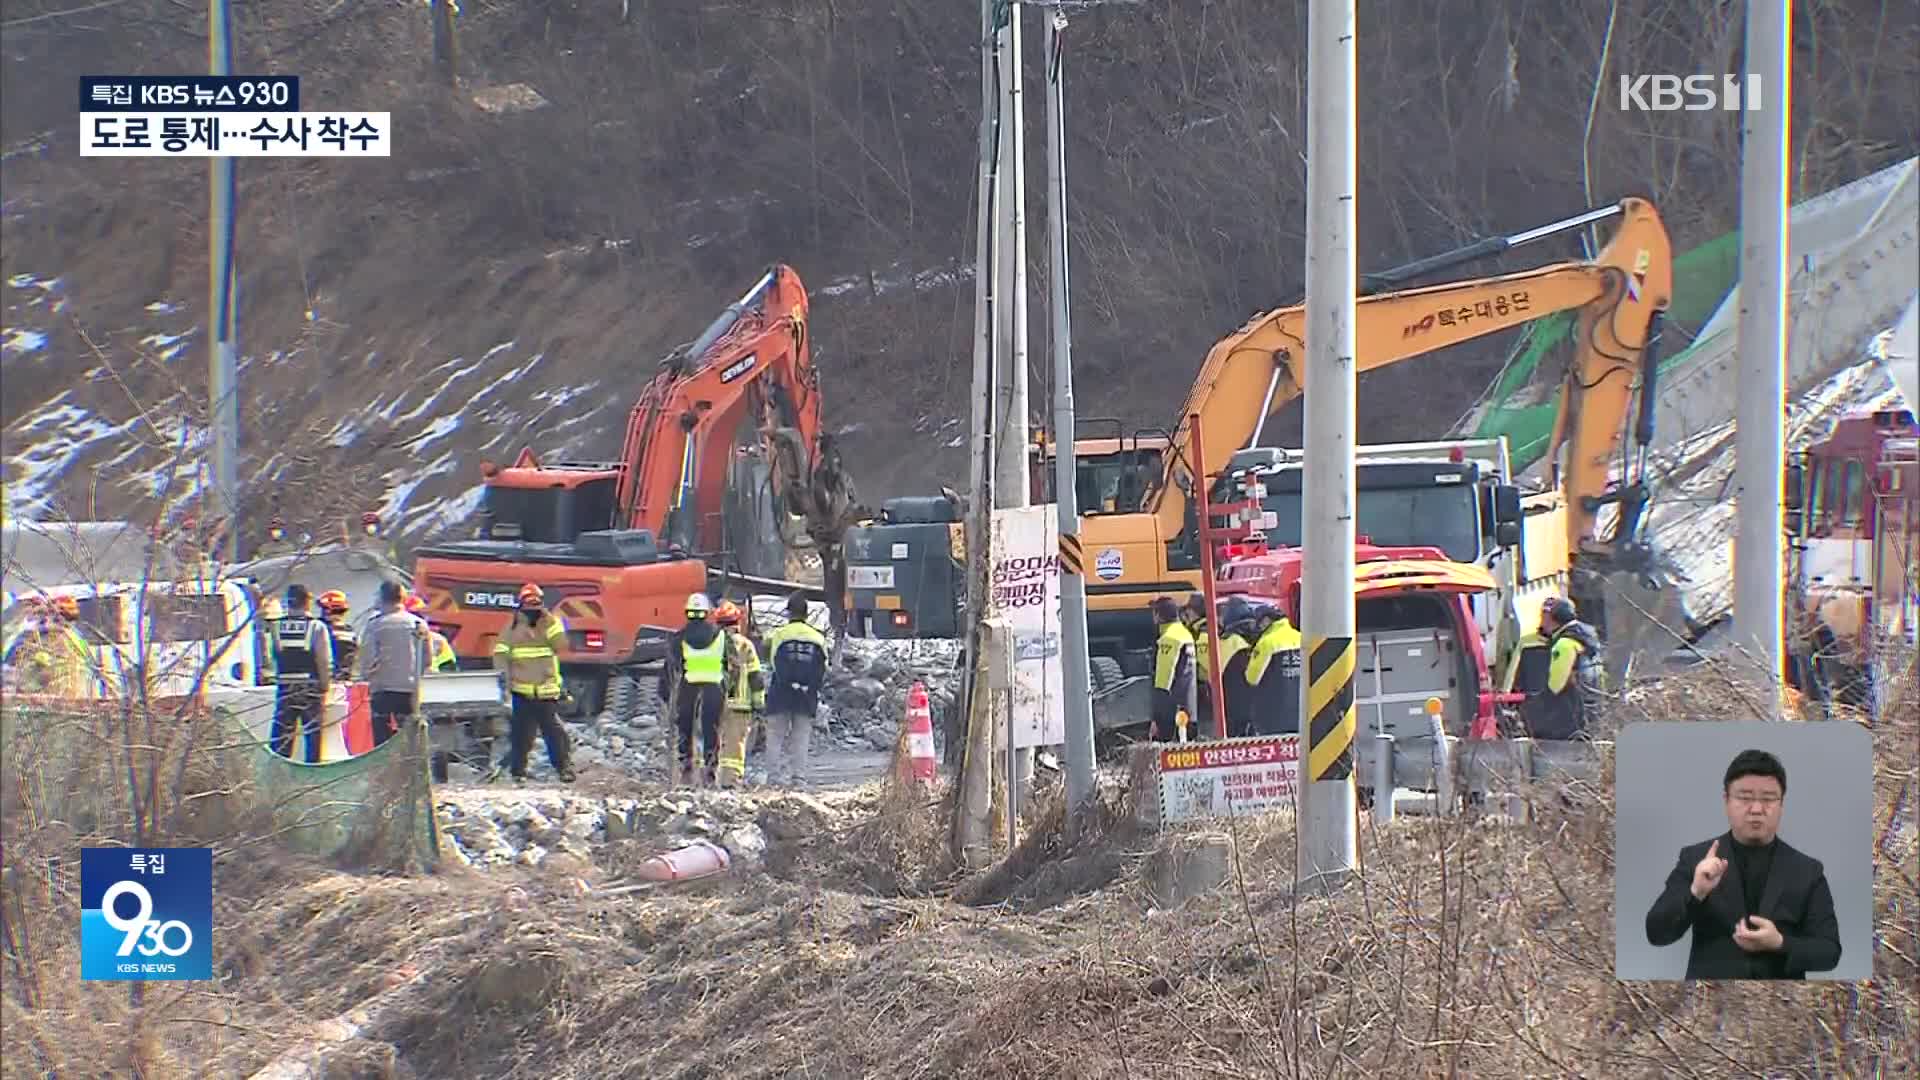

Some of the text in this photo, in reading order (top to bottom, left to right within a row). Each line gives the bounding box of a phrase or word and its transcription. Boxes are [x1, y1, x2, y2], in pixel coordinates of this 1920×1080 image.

[1437, 291, 1531, 327] 특수대응단
[464, 591, 522, 609] DEVEL
[1167, 742, 1299, 769] 위험! 안전보호구 착
[1266, 769, 1298, 782] 착용으
